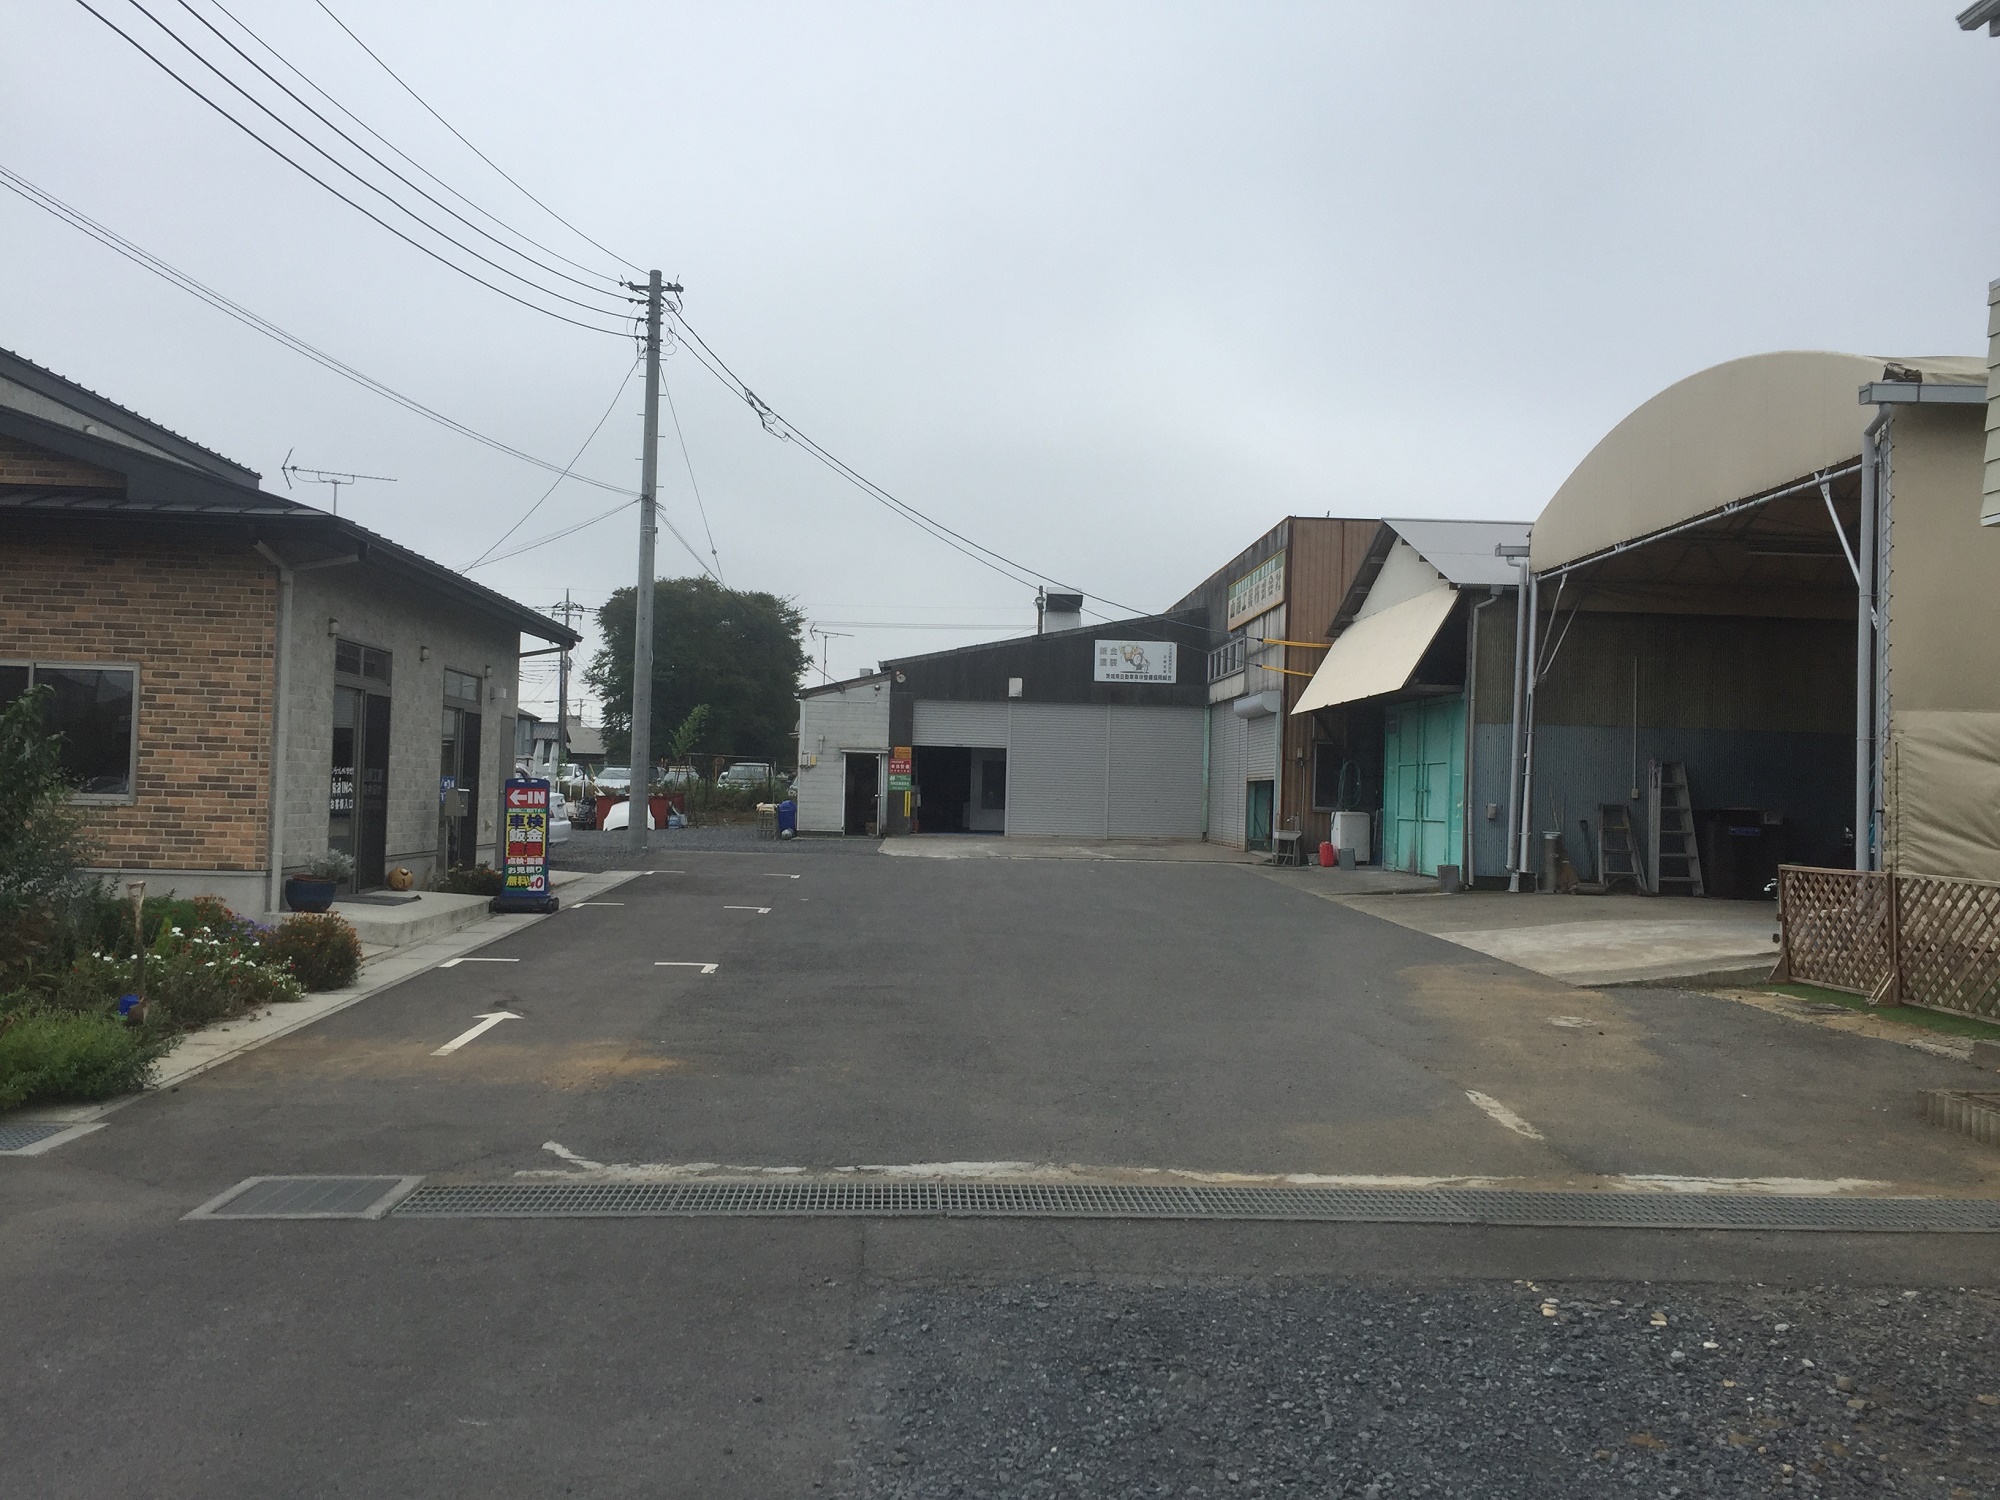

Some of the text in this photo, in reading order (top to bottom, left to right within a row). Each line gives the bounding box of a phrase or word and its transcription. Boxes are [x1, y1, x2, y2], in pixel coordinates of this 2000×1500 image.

[527, 791, 546, 804] IN
[508, 814, 544, 829] 車検
[508, 828, 543, 843] 鈑金
[508, 866, 542, 874] お見積り
